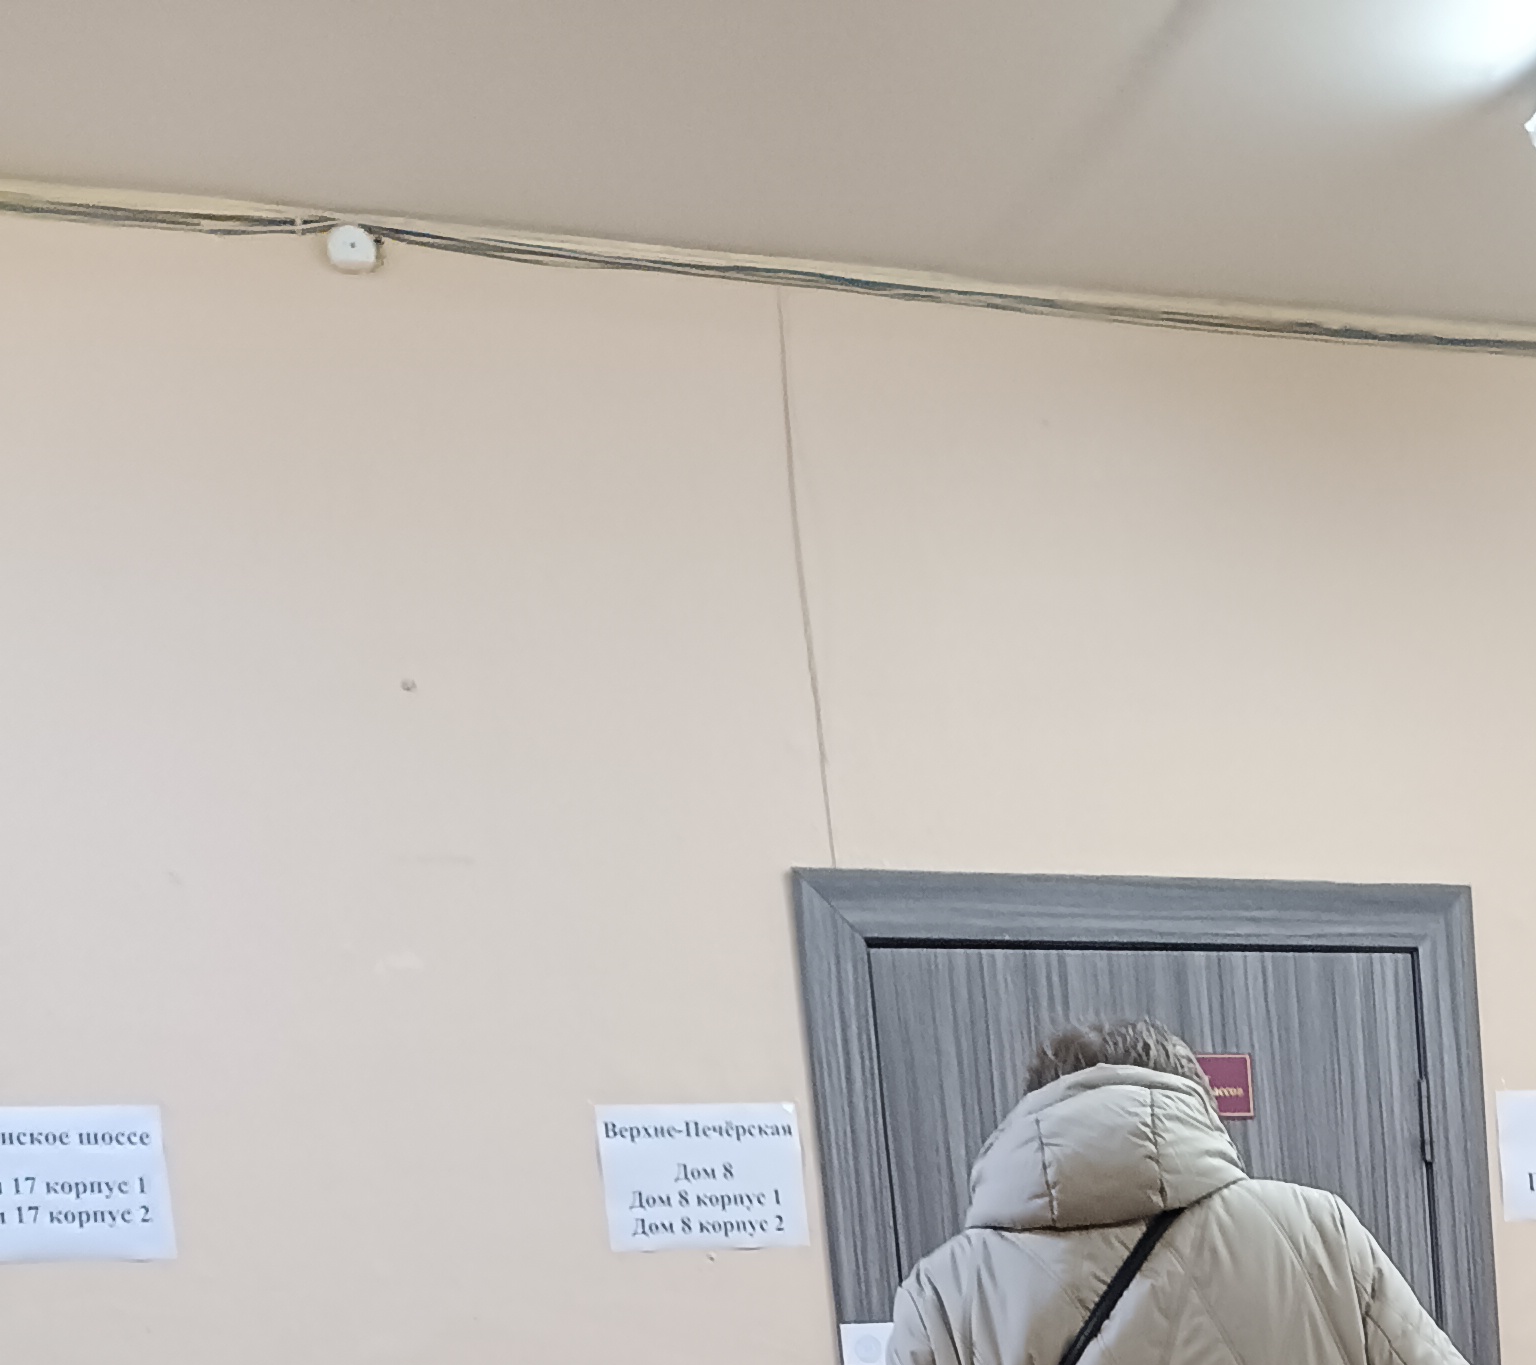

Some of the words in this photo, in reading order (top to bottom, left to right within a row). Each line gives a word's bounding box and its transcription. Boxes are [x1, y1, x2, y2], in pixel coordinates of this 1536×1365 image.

[0, 1130, 71, 1147] нское
[78, 1130, 151, 1147] шоссе
[603, 1120, 793, 1144] Верхне-Печёрская
[674, 1162, 717, 1184] Дом
[722, 1161, 735, 1181] 8
[13, 1176, 37, 1196] 17
[46, 1180, 130, 1200] корпус
[138, 1175, 147, 1195] 1
[629, 1190, 672, 1210] Дом
[678, 1189, 690, 1208] 8
[696, 1191, 767, 1212] корпус
[774, 1188, 782, 1206] 1
[17, 1205, 41, 1225] 17
[49, 1208, 133, 1230] корпус
[139, 1204, 153, 1224] 2
[632, 1217, 675, 1237] Дом
[680, 1216, 693, 1235] 8
[699, 1218, 769, 1238] корпус
[775, 1214, 786, 1232] 2
